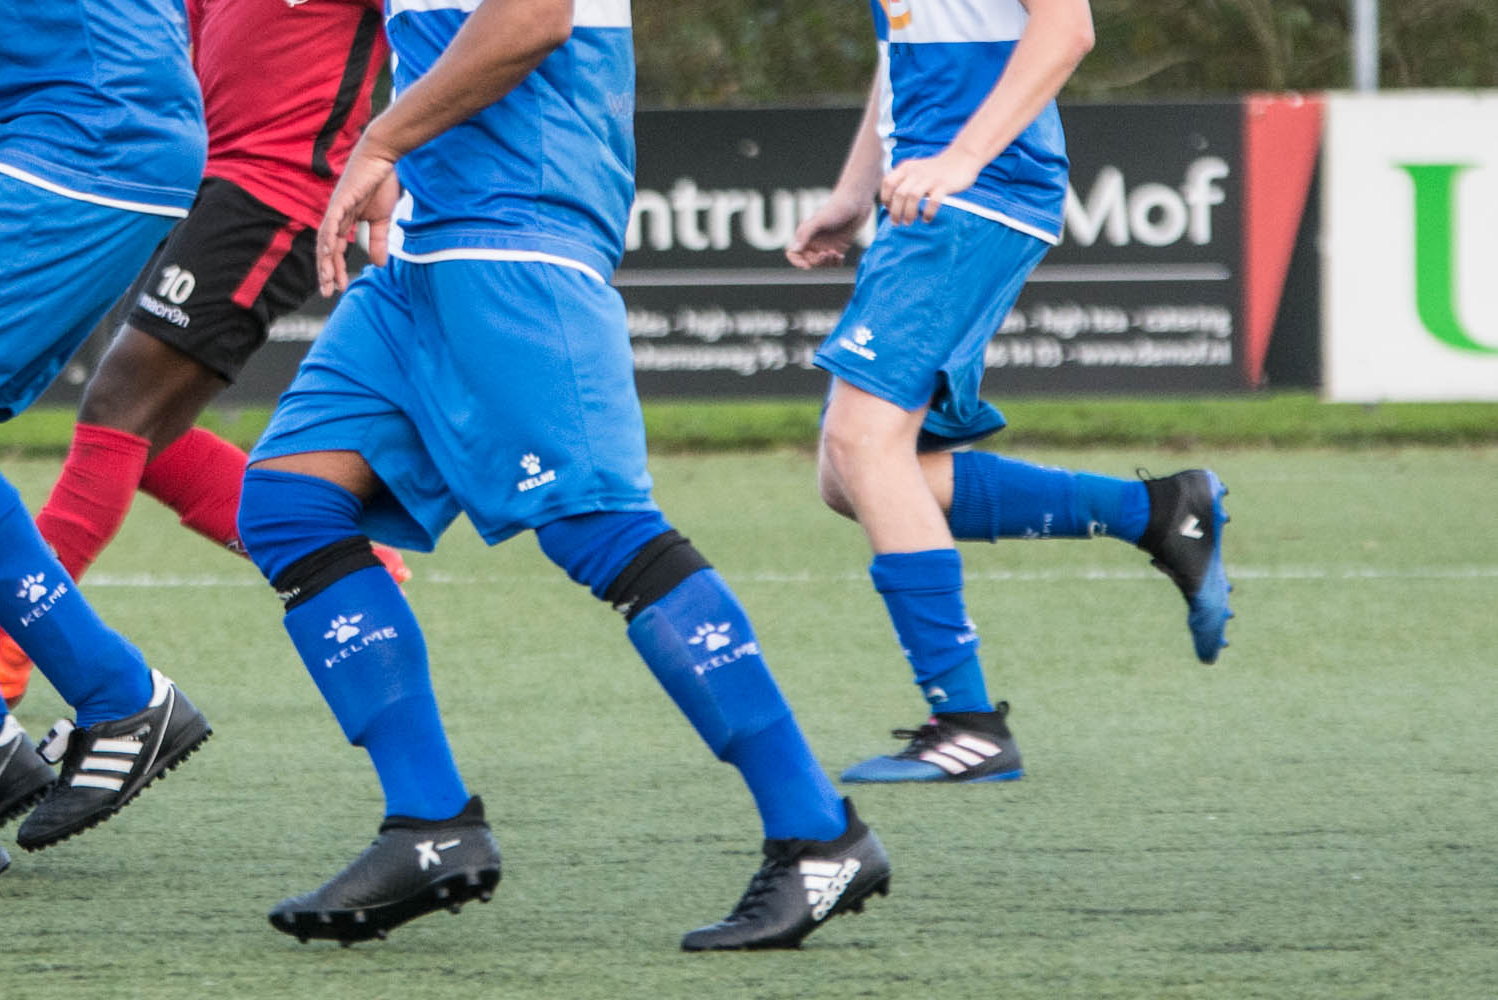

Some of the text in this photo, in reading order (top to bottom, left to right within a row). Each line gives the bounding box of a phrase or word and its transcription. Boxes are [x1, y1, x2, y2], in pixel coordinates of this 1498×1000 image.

[1060, 156, 1230, 248] Mof
[157, 264, 196, 305] 10
[517, 469, 556, 493] KELME
[20, 582, 69, 628] KELME
[324, 626, 399, 669] KELME
[693, 641, 759, 686] KELME
[811, 858, 862, 922] adidas
